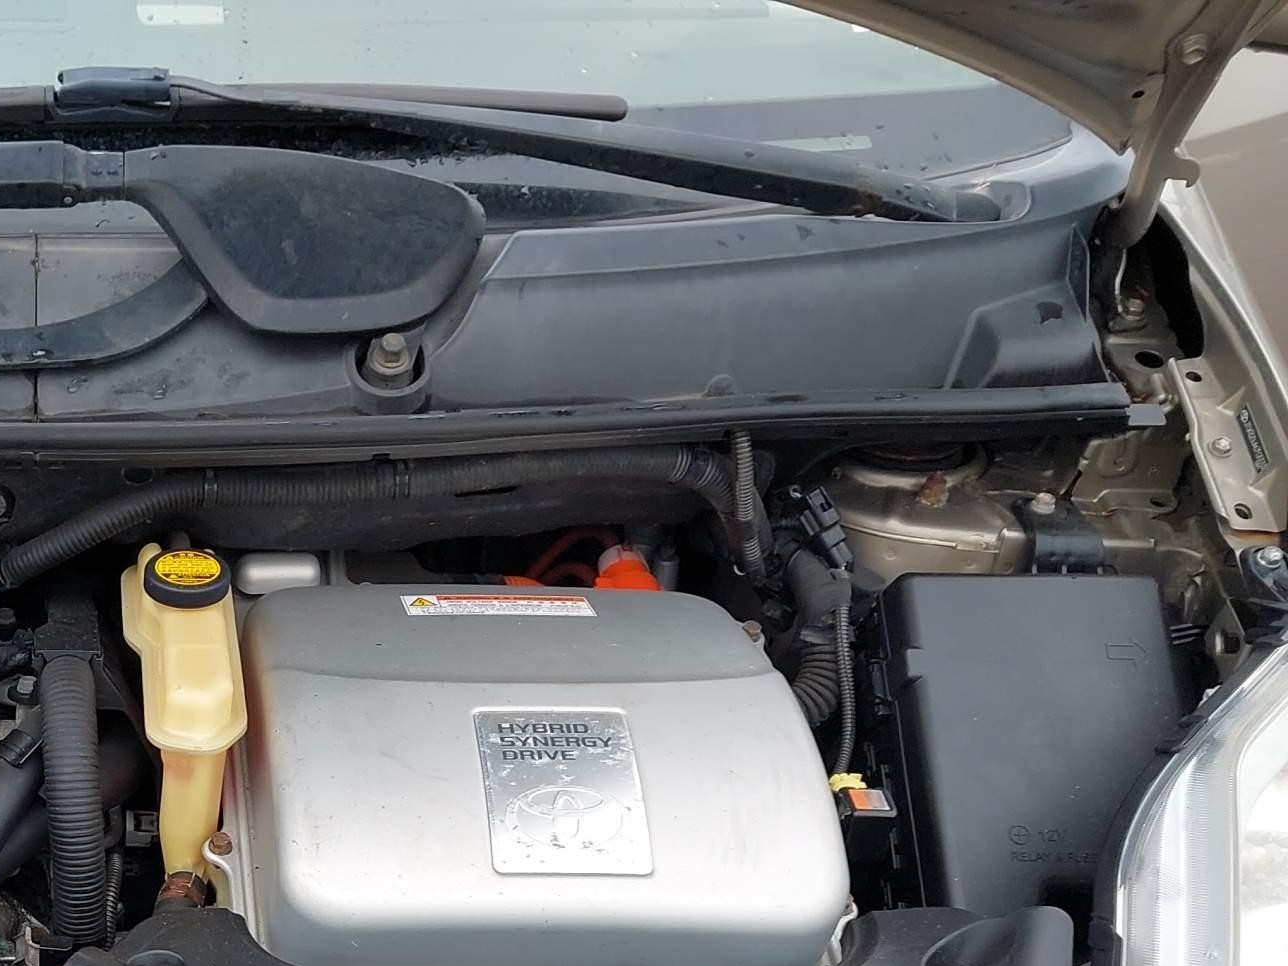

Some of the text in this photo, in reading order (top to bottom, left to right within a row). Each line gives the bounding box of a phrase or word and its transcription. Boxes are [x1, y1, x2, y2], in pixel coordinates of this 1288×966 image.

[498, 723, 589, 733] HYBRID
[500, 737, 612, 747] SYNERGY
[502, 750, 577, 760] DRIVE
